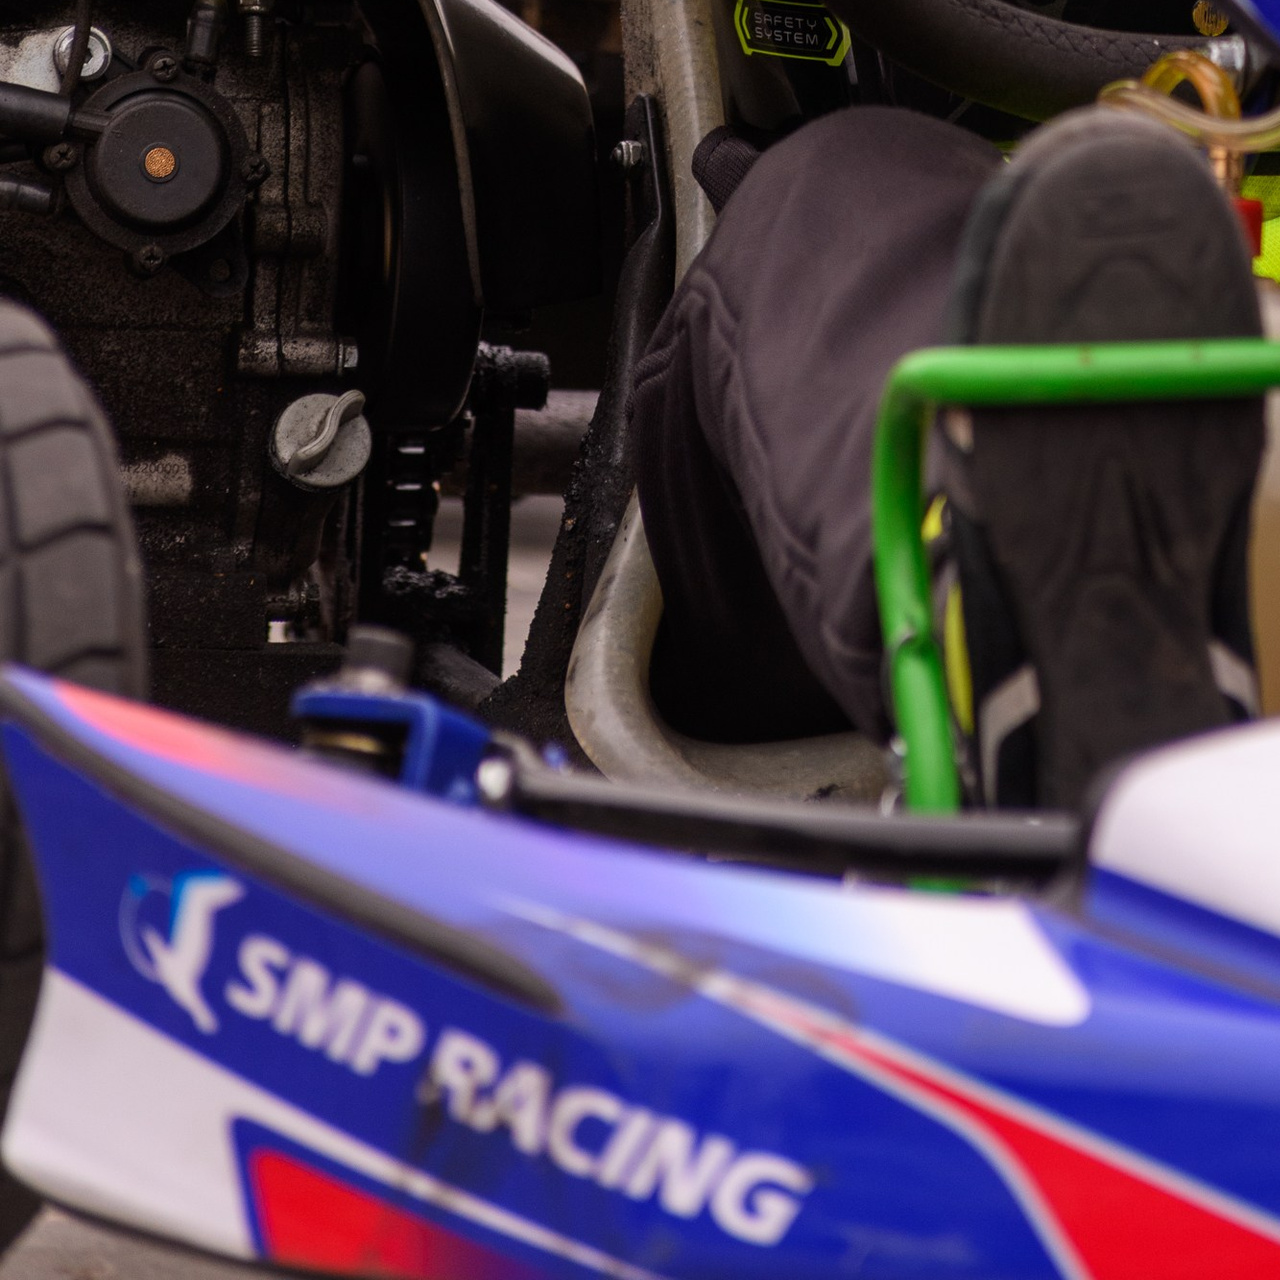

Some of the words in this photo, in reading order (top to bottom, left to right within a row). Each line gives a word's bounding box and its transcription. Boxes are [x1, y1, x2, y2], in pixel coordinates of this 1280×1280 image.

[754, 12, 817, 30] SAFETY
[755, 27, 818, 45] SYSTEM
[226, 935, 425, 1076] SMP
[422, 1028, 812, 1246] RACING
